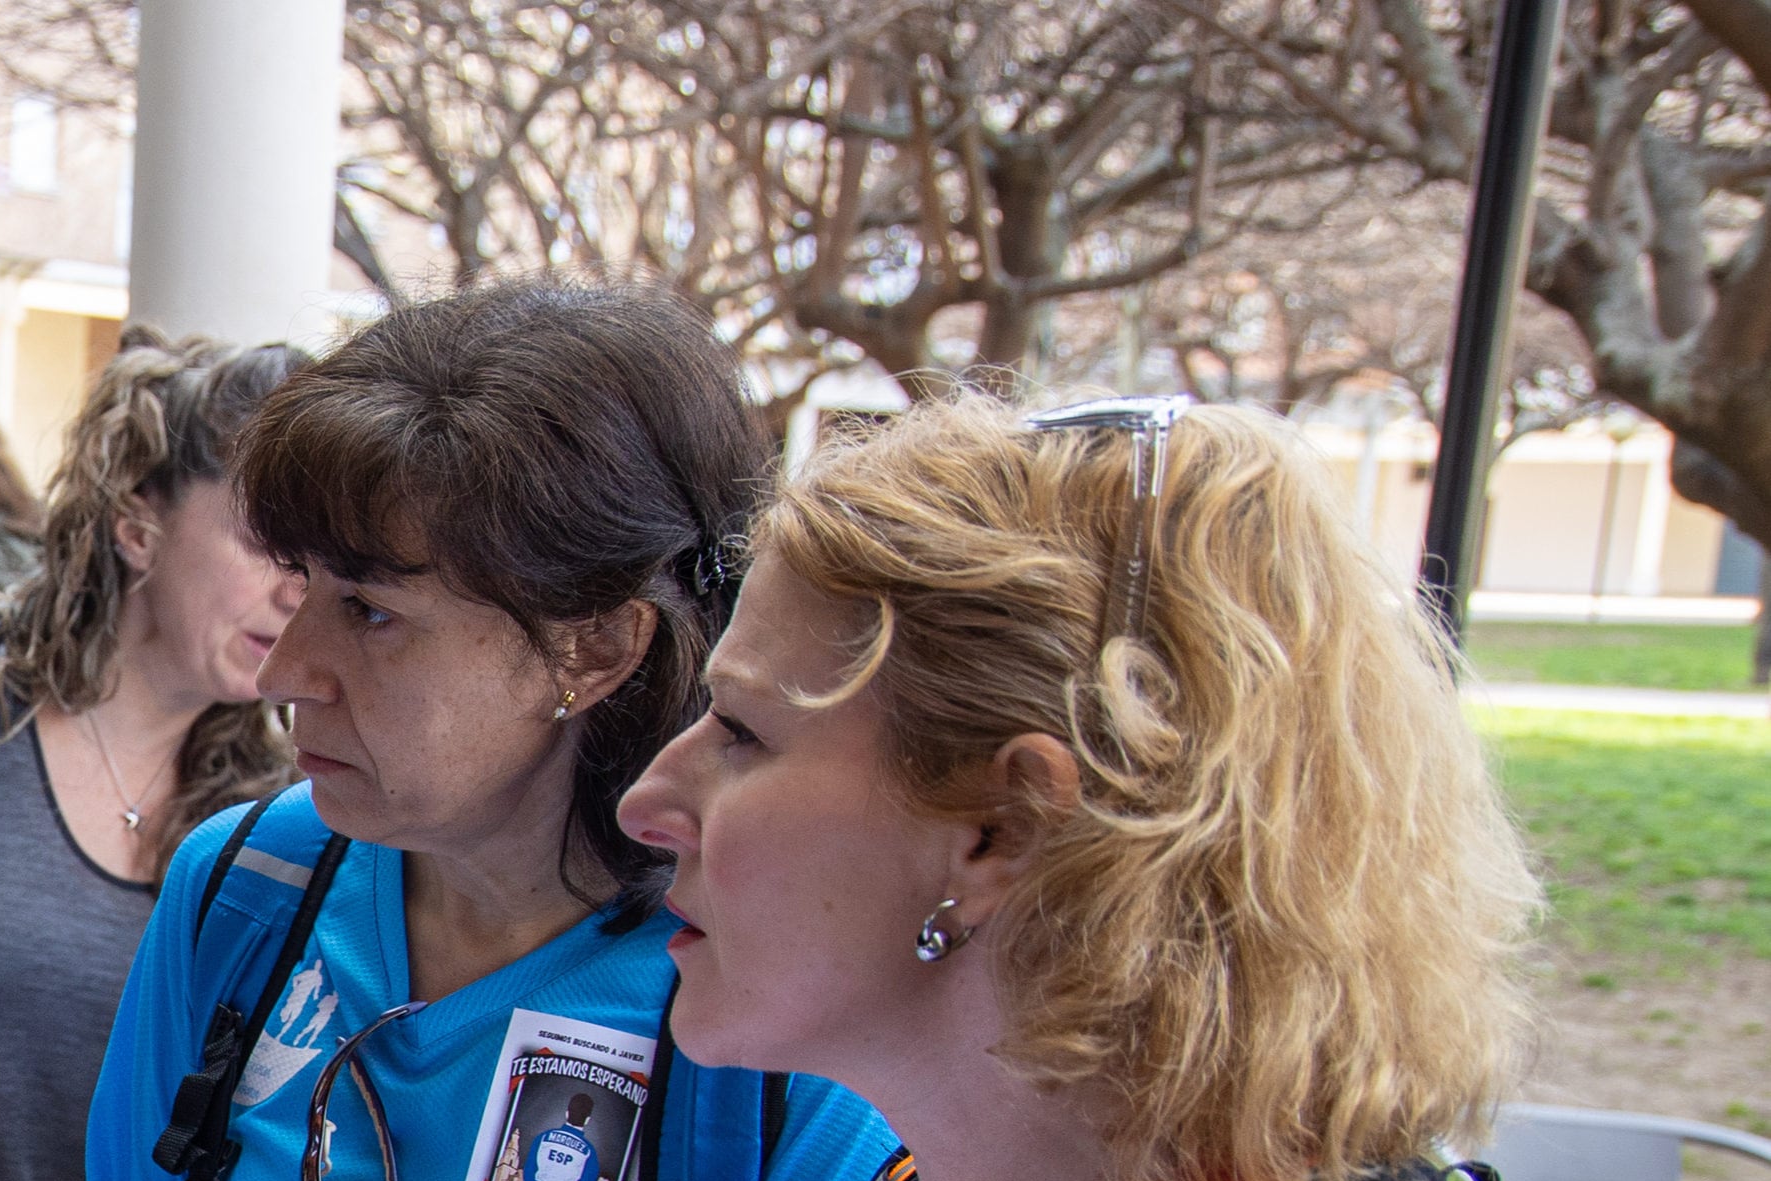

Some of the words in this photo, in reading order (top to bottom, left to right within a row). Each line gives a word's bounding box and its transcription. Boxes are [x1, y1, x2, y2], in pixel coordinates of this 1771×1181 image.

[538, 1030, 571, 1044] SEGUIMOS
[573, 1038, 609, 1053] BUSCANDO
[618, 1051, 645, 1063] JAVIER
[512, 1057, 529, 1076] TE
[528, 1057, 589, 1080] ESTAMOS
[549, 1132, 587, 1152] MARQUEZ
[548, 1149, 573, 1165] ESP
